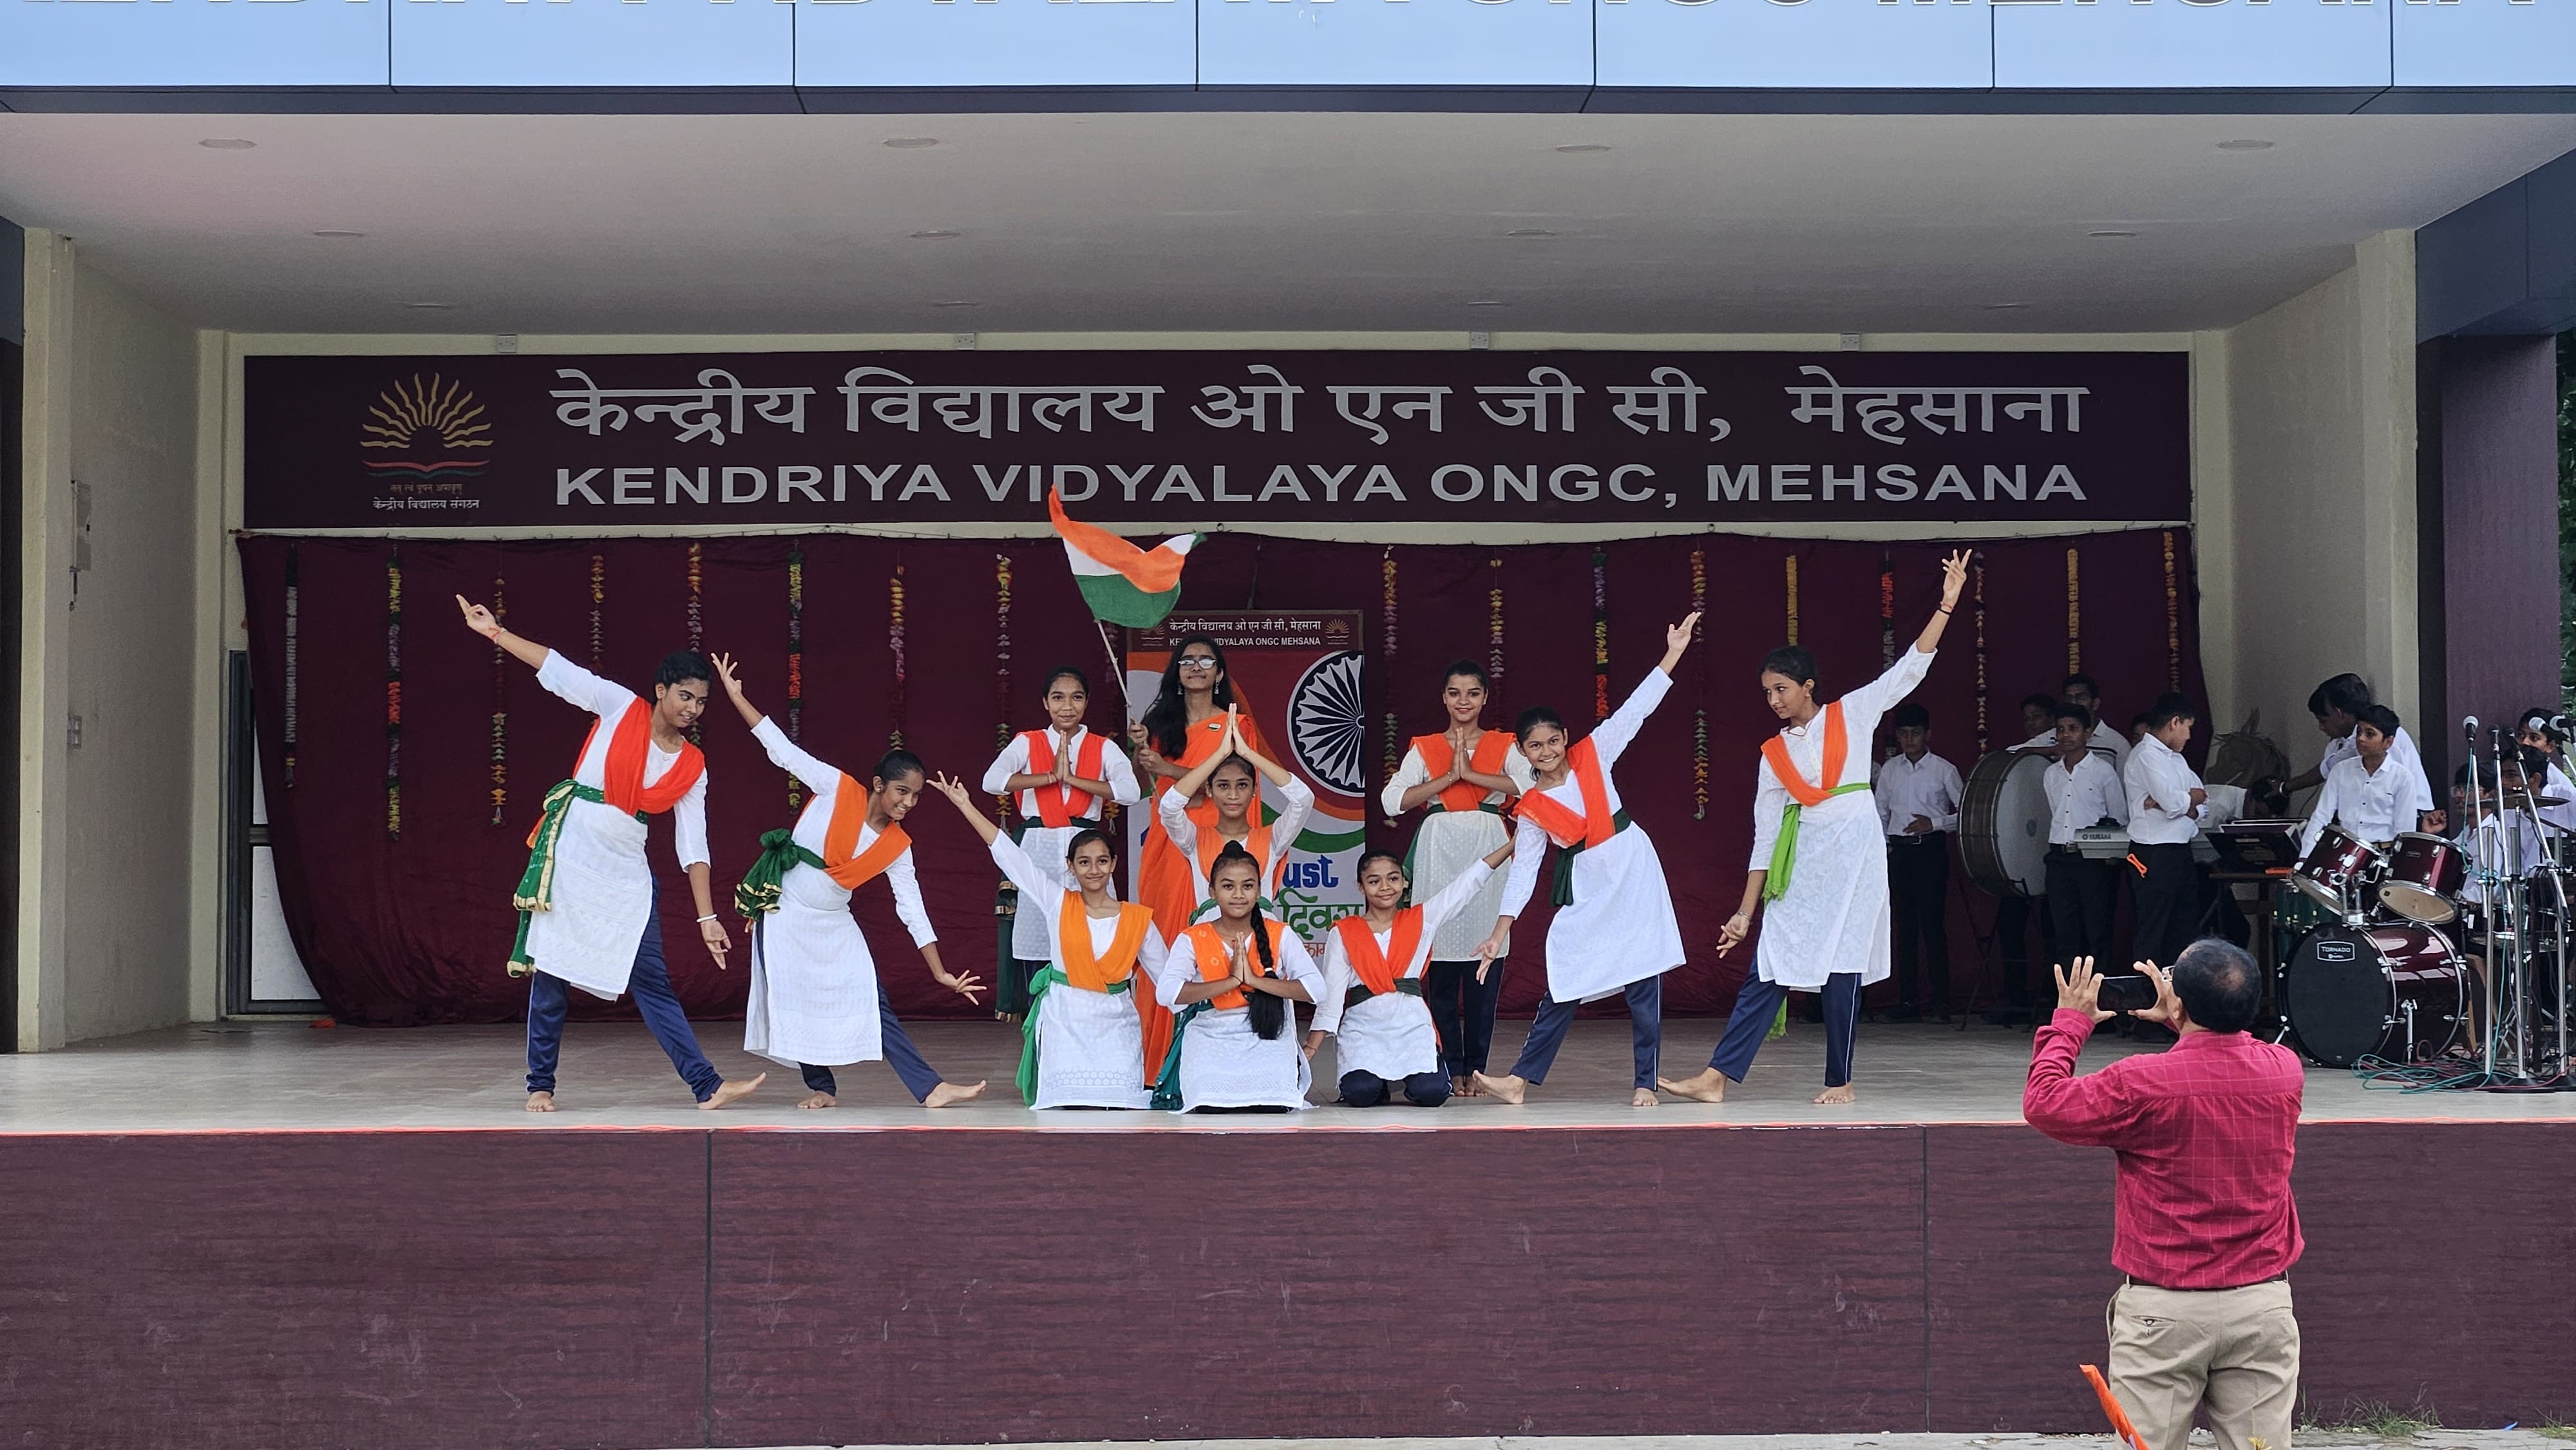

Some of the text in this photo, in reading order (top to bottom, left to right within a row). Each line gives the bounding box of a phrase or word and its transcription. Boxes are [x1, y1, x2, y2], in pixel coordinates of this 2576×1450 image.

[549, 364, 2090, 446] केन्द्रीय विद्यालय ओ एन जी सी, मेहसाना
[556, 464, 2087, 509] KENDRIYA VIDYALAYA ONGC, MEHSANA
[408, 496, 447, 509] विद्यालय
[450, 496, 480, 509] संगठन
[1170, 618, 1197, 632] केन्द्रीय
[1197, 618, 1233, 631] विद्यालय
[1235, 617, 1247, 630] ओ
[1248, 621, 1260, 632] एन
[1260, 618, 1273, 630] जी
[1289, 617, 1321, 632] मेहसाना
[1255, 637, 1279, 646] ONGC
[1281, 637, 1321, 646] MEHSANA
